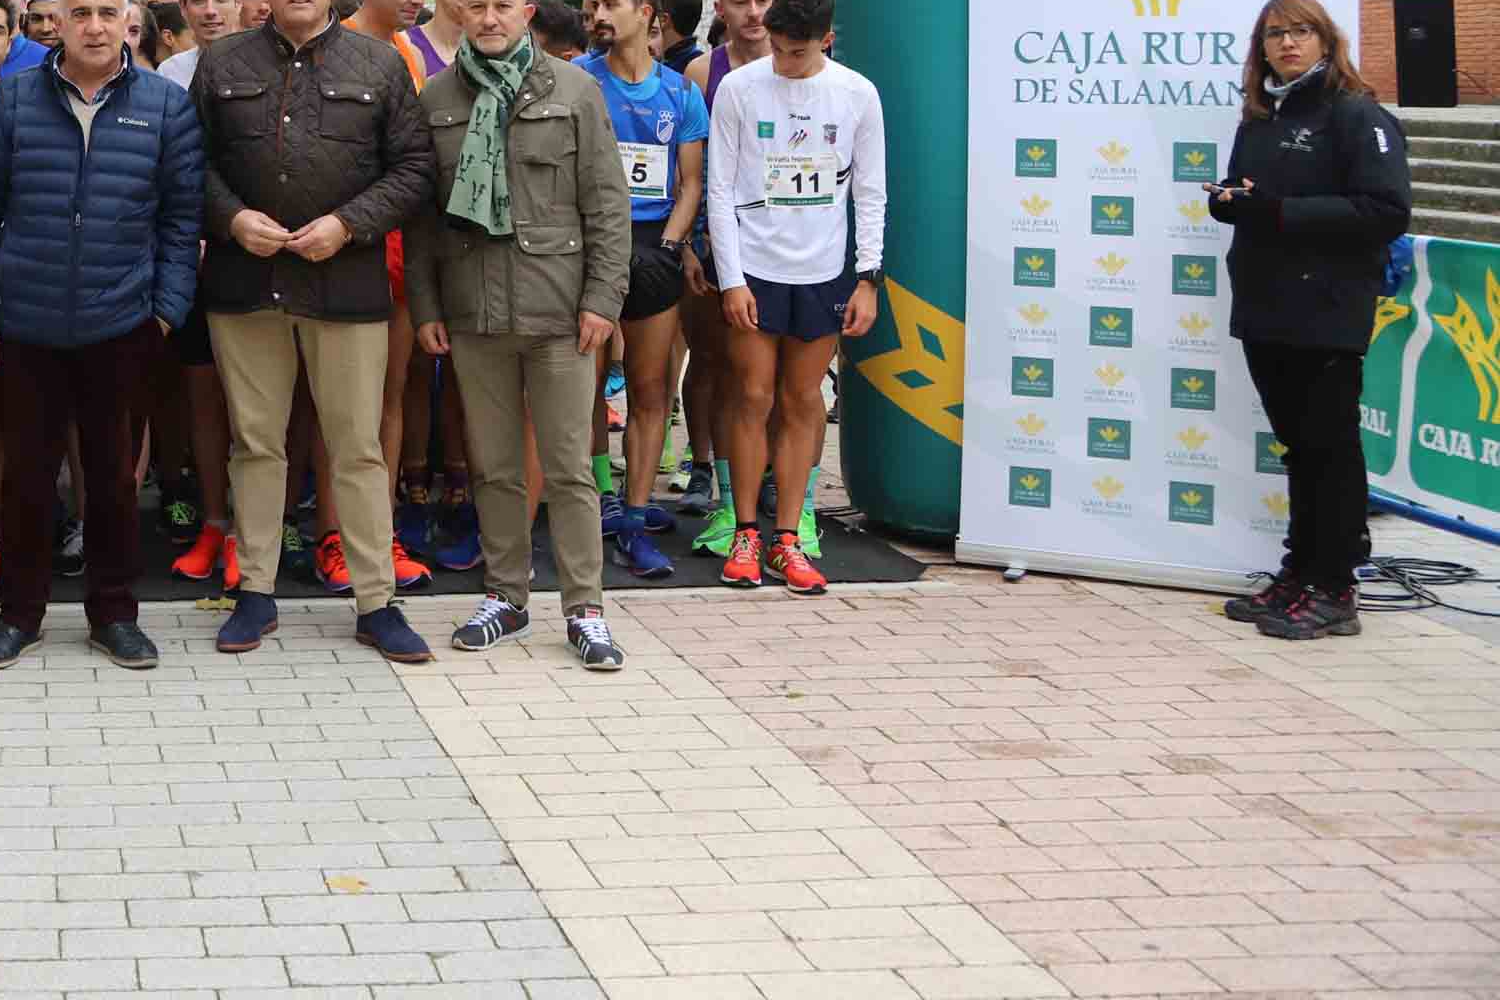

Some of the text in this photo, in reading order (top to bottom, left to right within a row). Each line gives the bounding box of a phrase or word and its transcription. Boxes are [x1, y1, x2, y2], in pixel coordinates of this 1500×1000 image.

[1013, 30, 1244, 74] CAJA RUR
[1012, 78, 1245, 106] DE SALAMAN
[631, 162, 647, 183] 5
[791, 172, 819, 194] 11
[1359, 403, 1392, 438] RAL
[1418, 422, 1477, 462] CAJA
